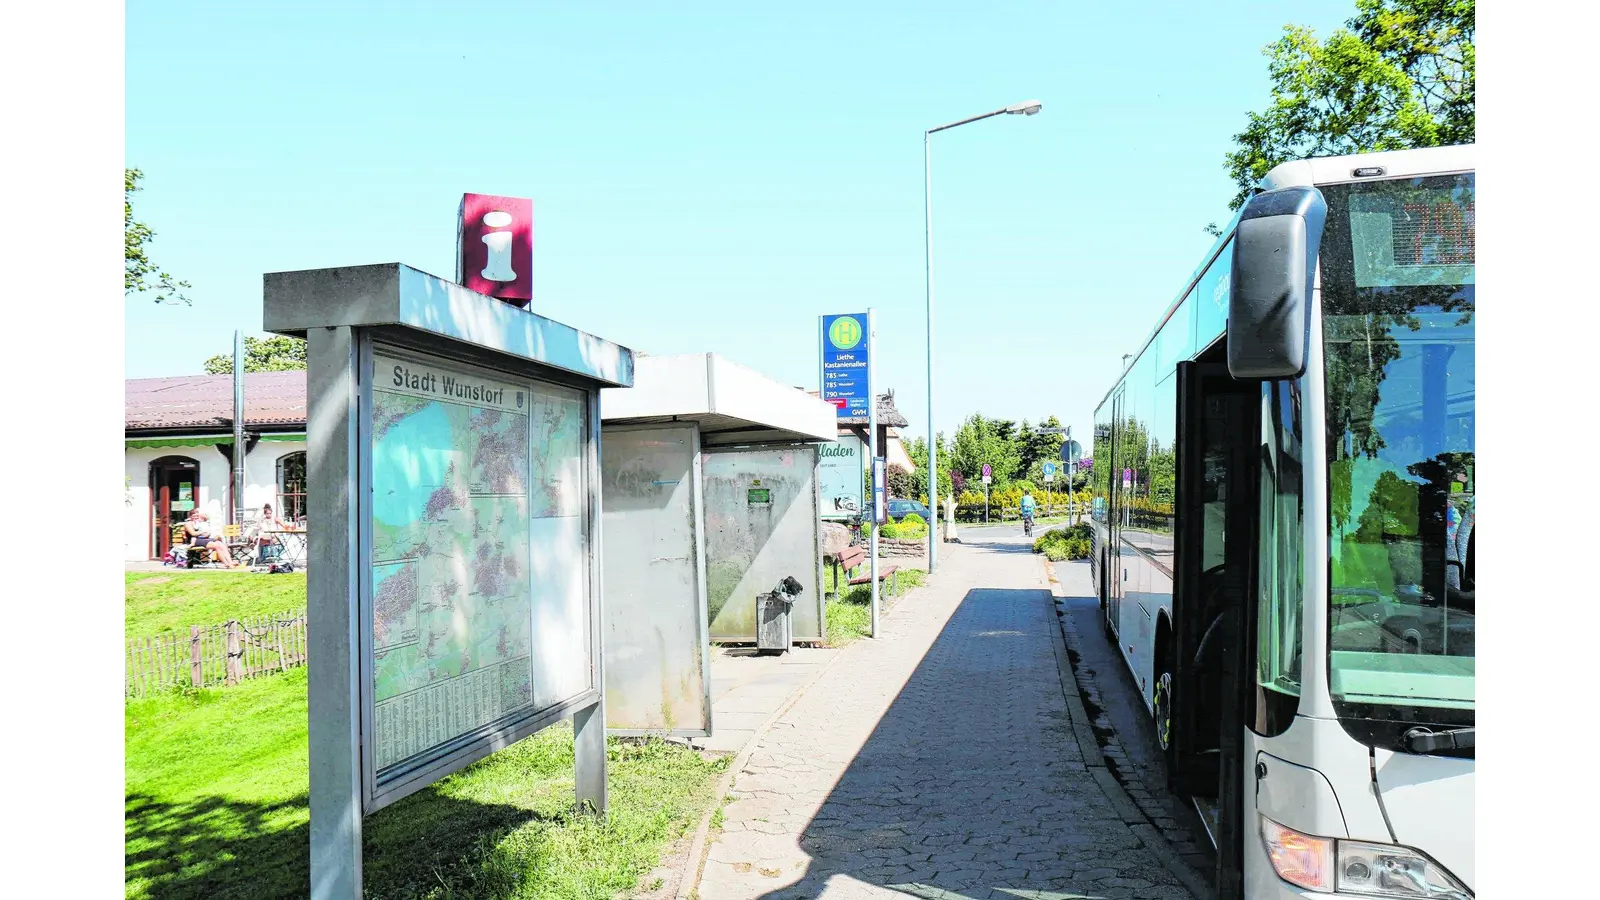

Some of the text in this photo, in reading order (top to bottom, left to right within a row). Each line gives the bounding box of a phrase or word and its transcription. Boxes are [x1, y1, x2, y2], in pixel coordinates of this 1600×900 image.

[481, 211, 517, 282] i
[839, 323, 852, 342] H
[824, 361, 867, 369] Kastanienallee
[393, 365, 504, 405] Stadt Wunstorf
